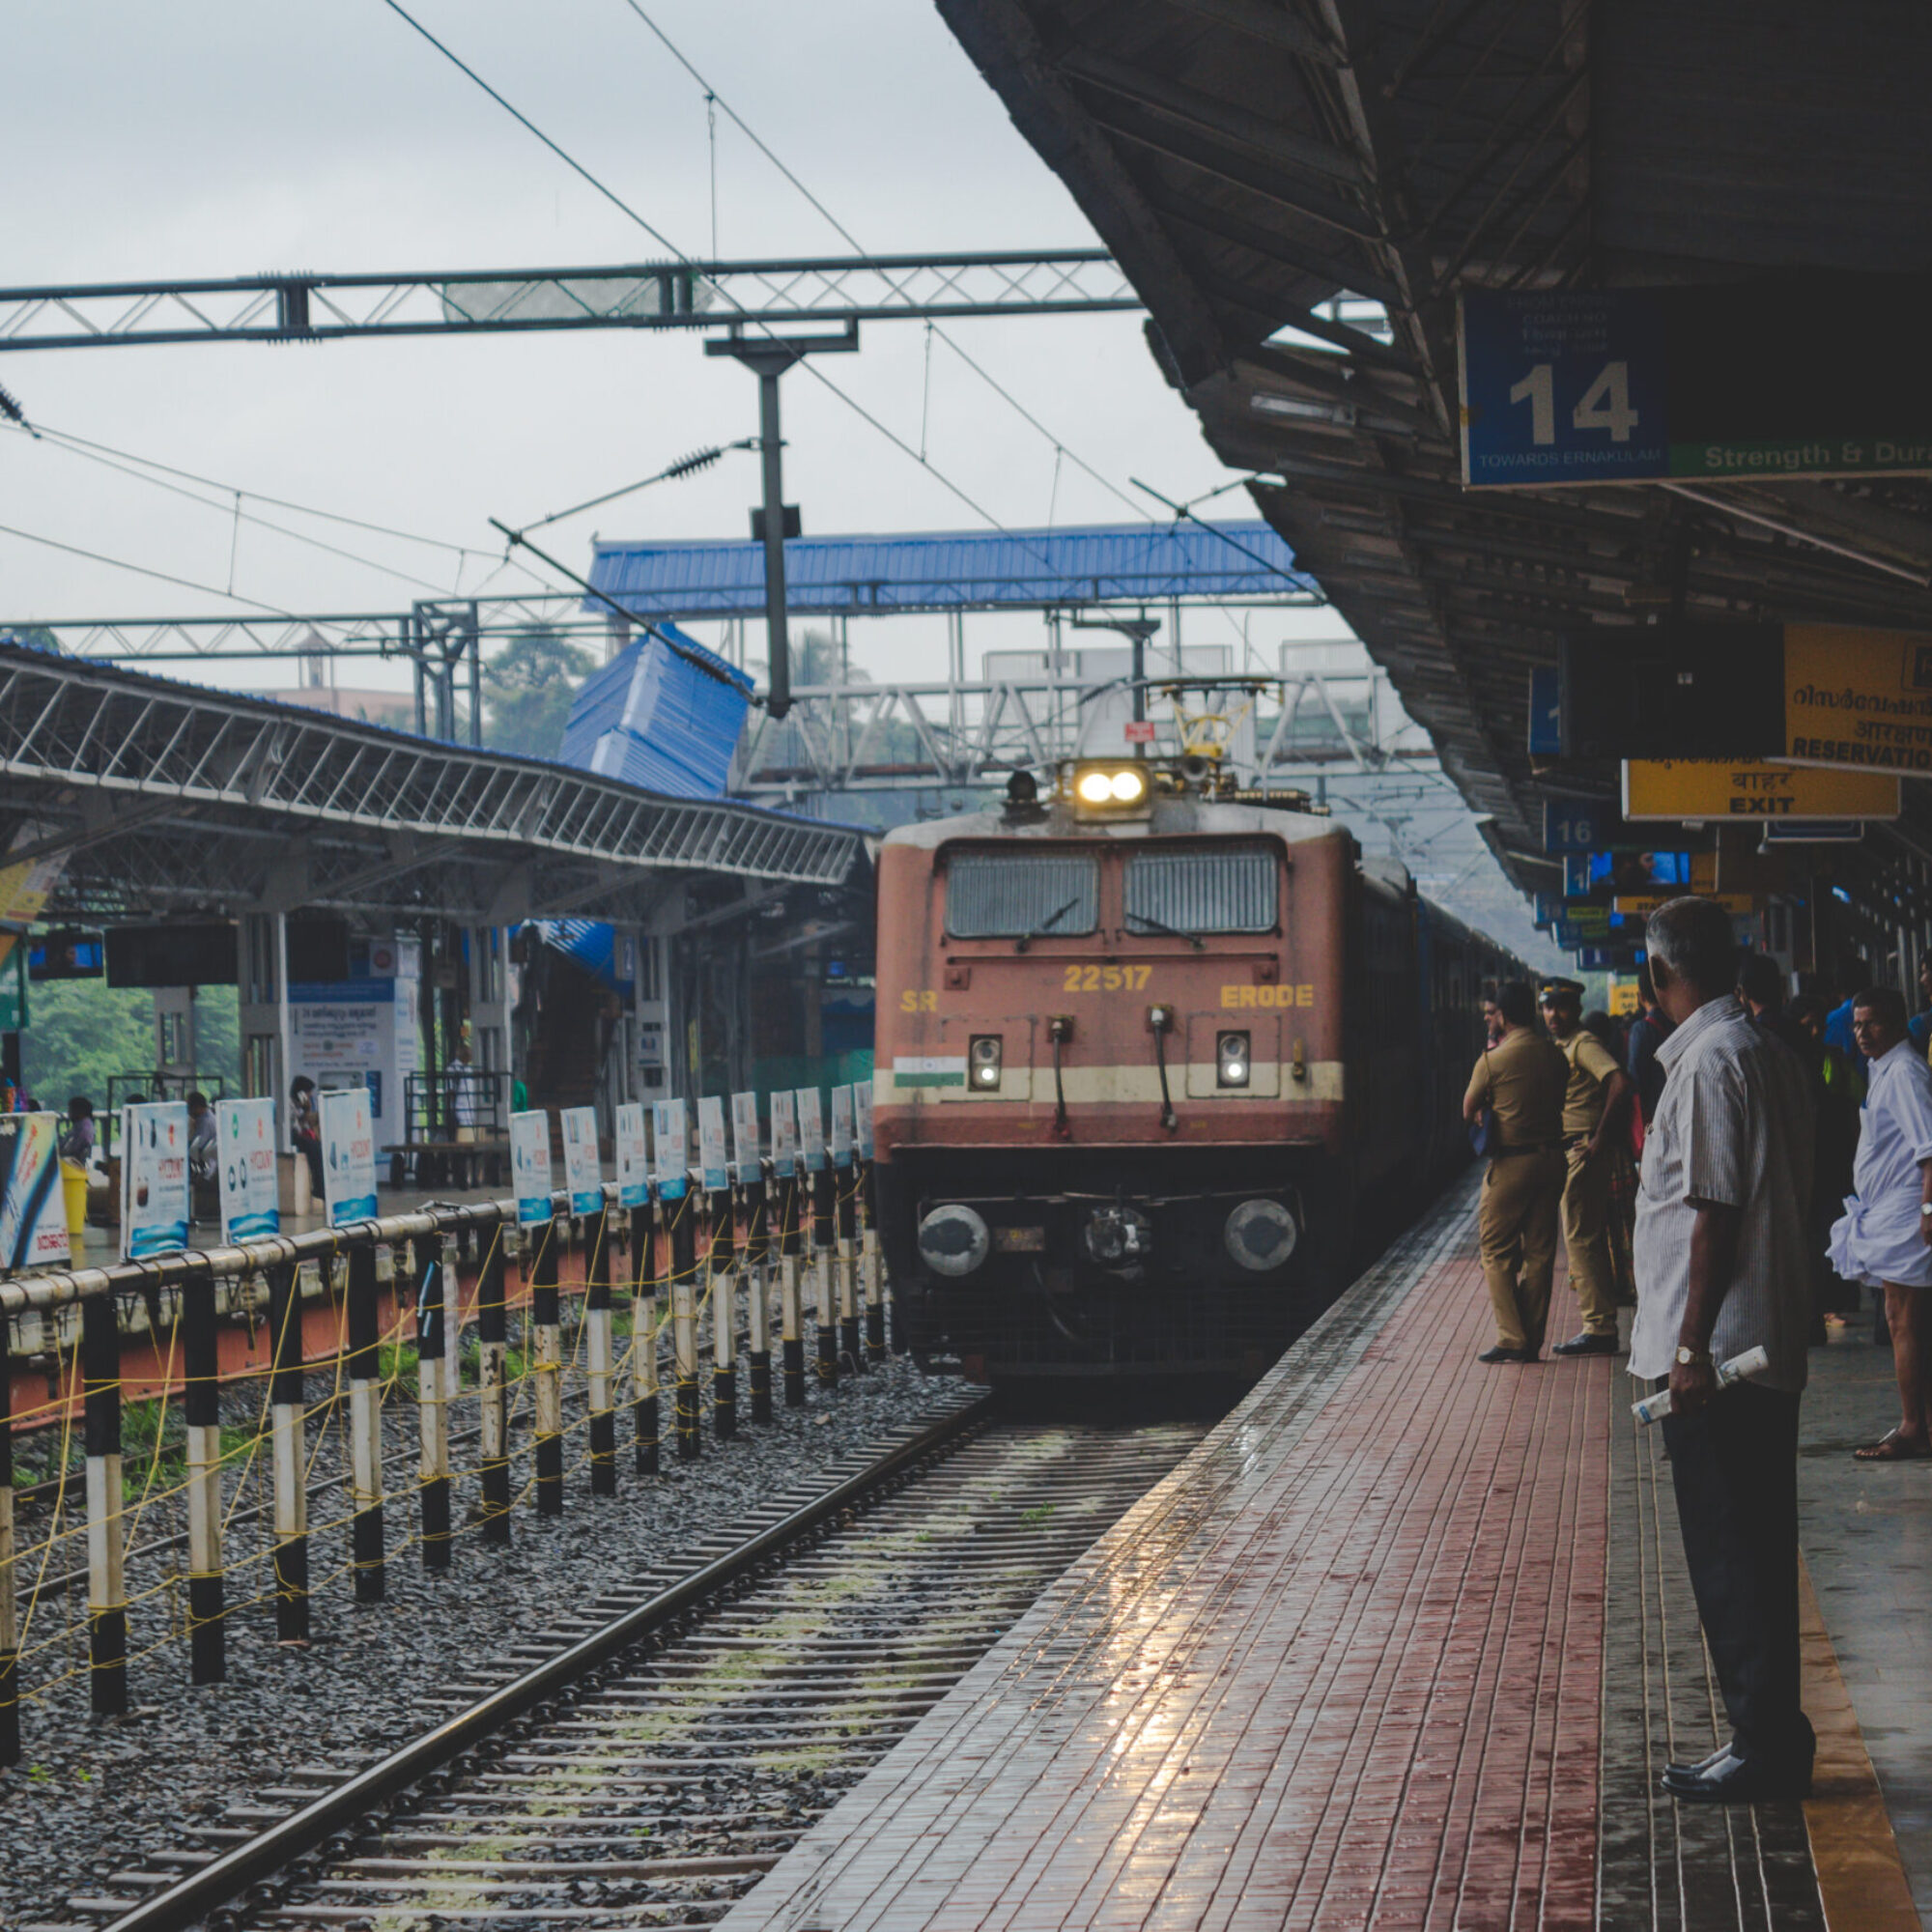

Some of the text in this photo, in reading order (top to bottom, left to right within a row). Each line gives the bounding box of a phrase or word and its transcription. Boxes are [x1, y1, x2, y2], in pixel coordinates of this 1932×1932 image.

[1510, 361, 1638, 445] 14
[1480, 448, 1662, 469] TOWARDS ERNAKULAM
[1704, 442, 1831, 469] Strength
[1841, 442, 1863, 464] &
[1731, 772, 1792, 789] बाहर
[1729, 797, 1795, 814] EXIT
[1556, 820, 1592, 843] 16
[1063, 965, 1153, 992] 22517
[898, 989, 940, 1013] SR
[1219, 983, 1315, 1009] ERODE
